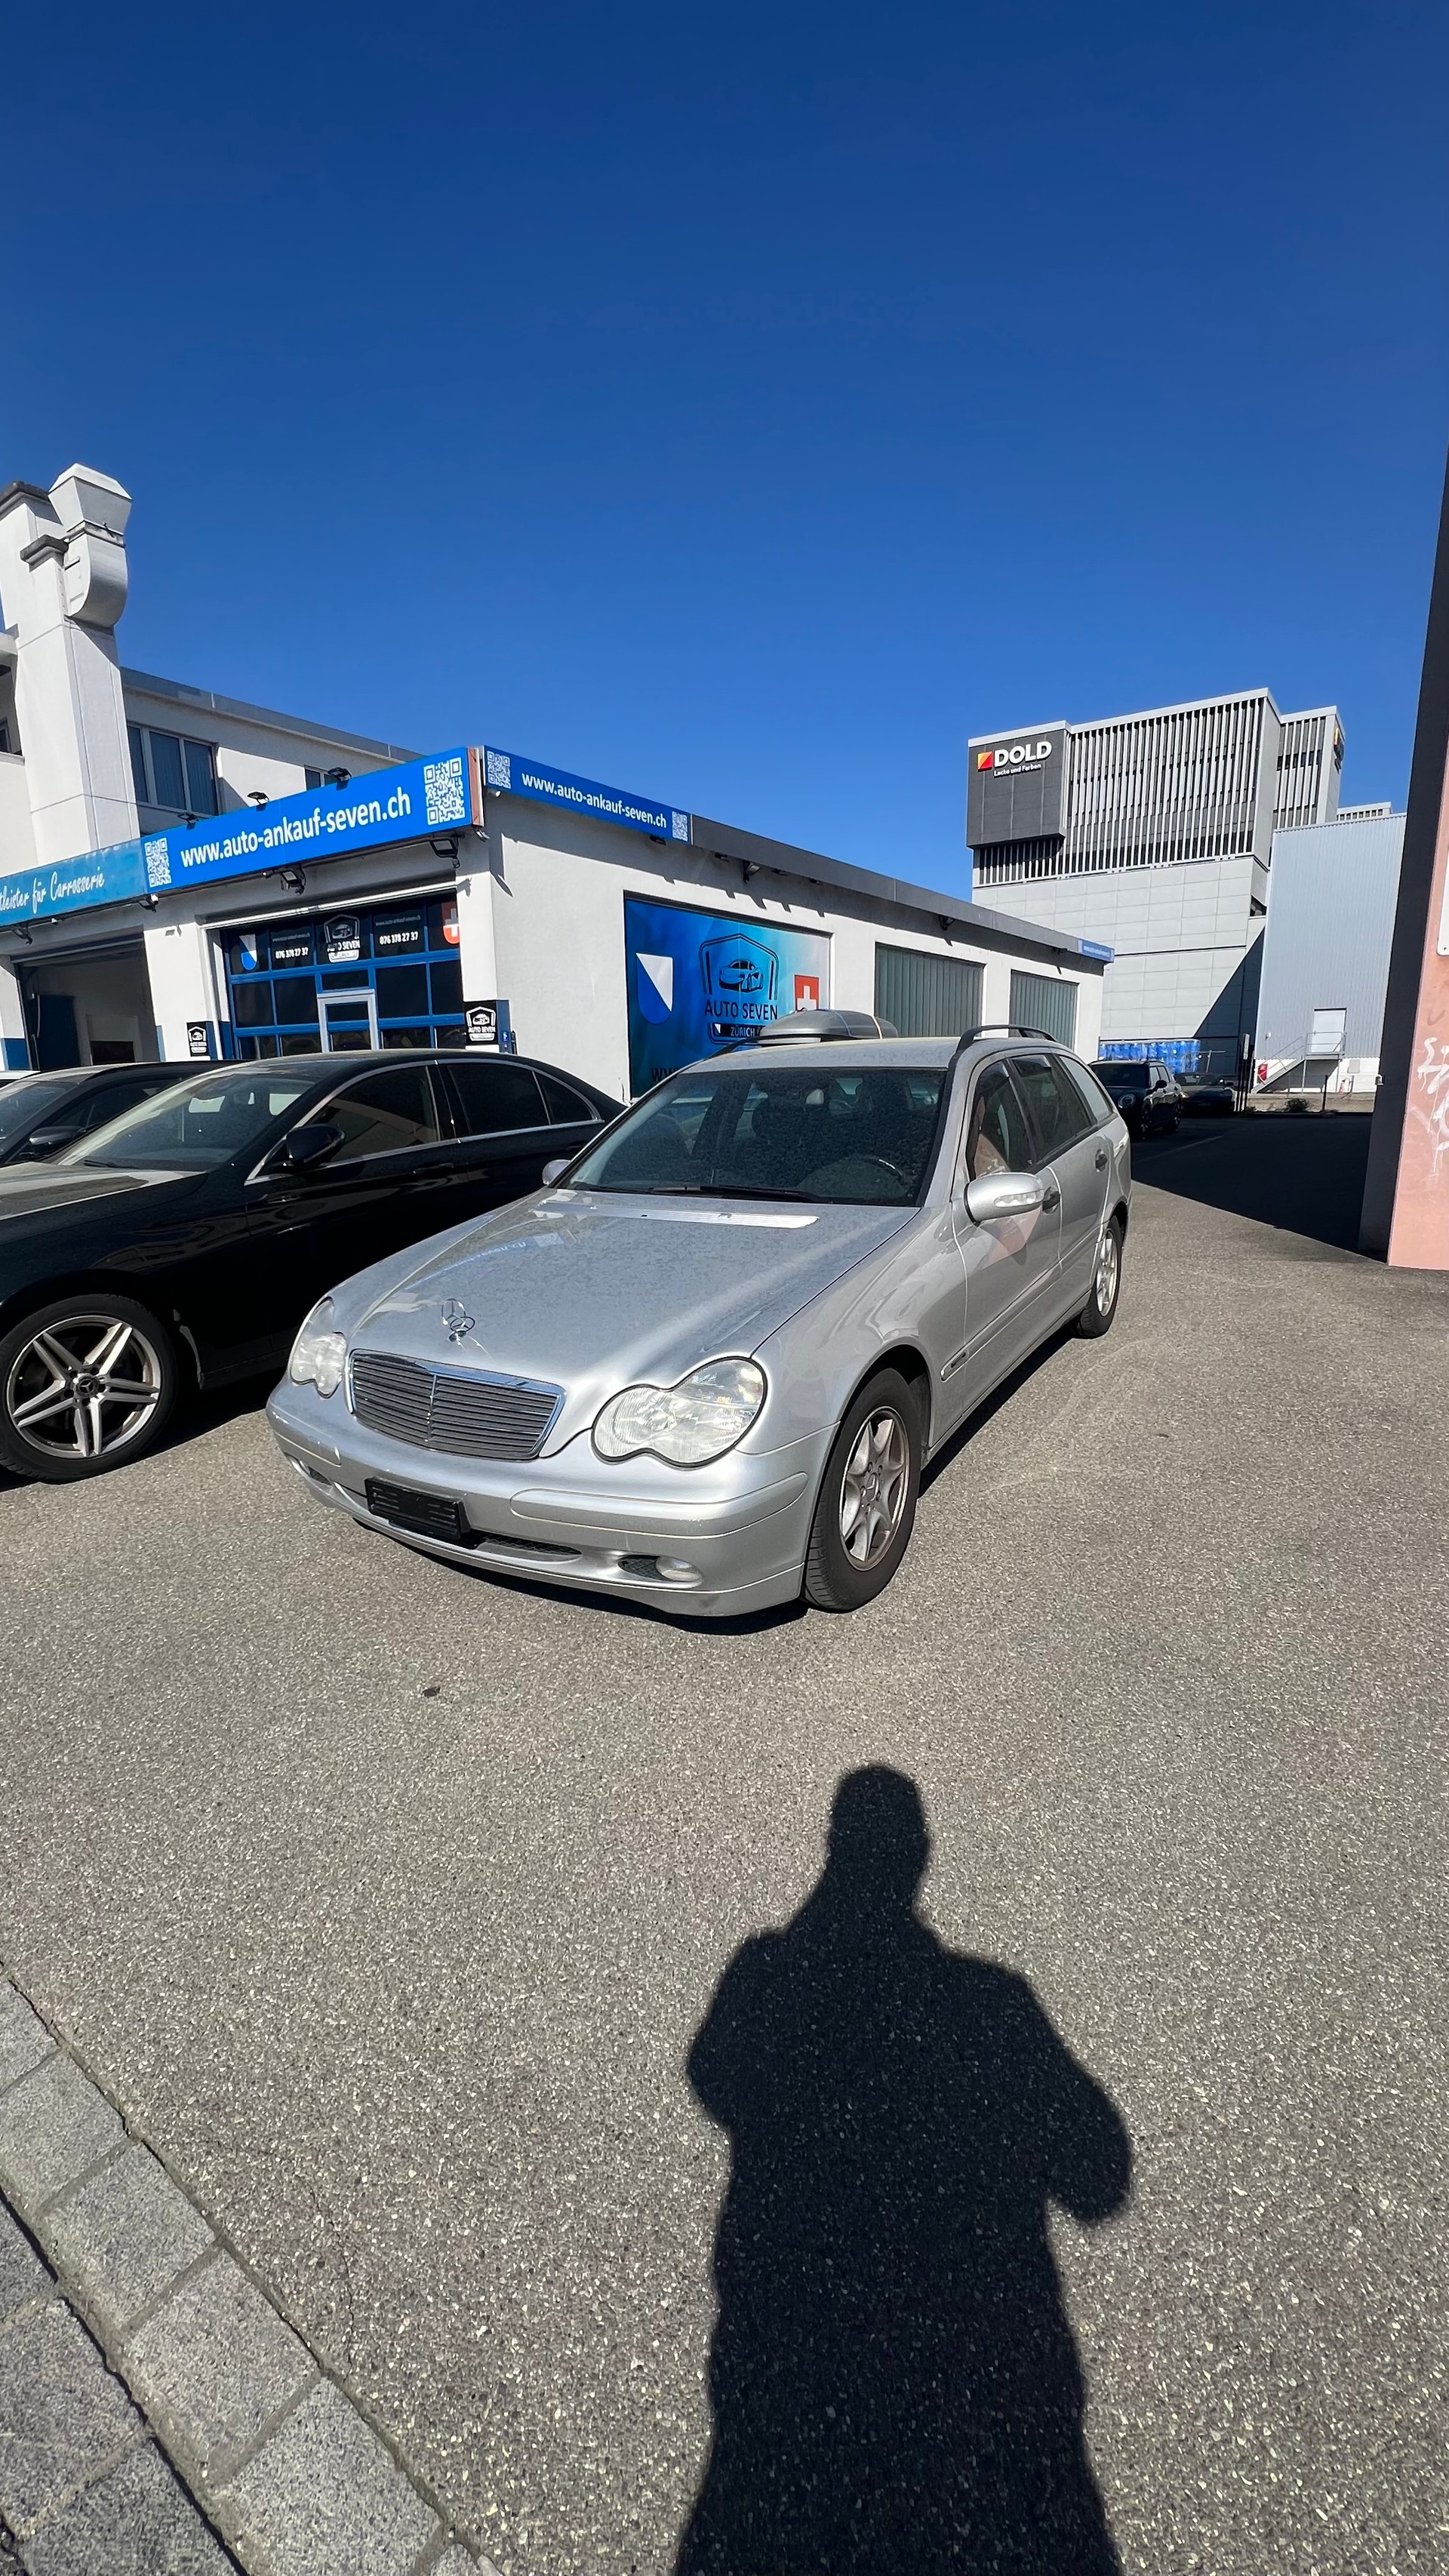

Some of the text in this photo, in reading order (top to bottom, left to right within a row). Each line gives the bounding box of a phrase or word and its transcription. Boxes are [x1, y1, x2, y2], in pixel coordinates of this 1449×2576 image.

[994, 740, 1052, 768] DOLD
[1011, 765, 1021, 774] und
[1022, 763, 1041, 771] Farben
[521, 773, 667, 828] www.auto-ankauf-seven.ch
[180, 786, 411, 868] www.auto-ankauf-seven.ch
[32, 877, 47, 914] für
[50, 866, 105, 901] Carrosserie
[342, 940, 361, 950] SEVEN
[379, 935, 391, 945] 076
[401, 932, 410, 942] 27
[411, 931, 419, 941] 37
[705, 1000, 778, 1020] AUTO SEVEN
[731, 1025, 755, 1037] ZÜRICH
